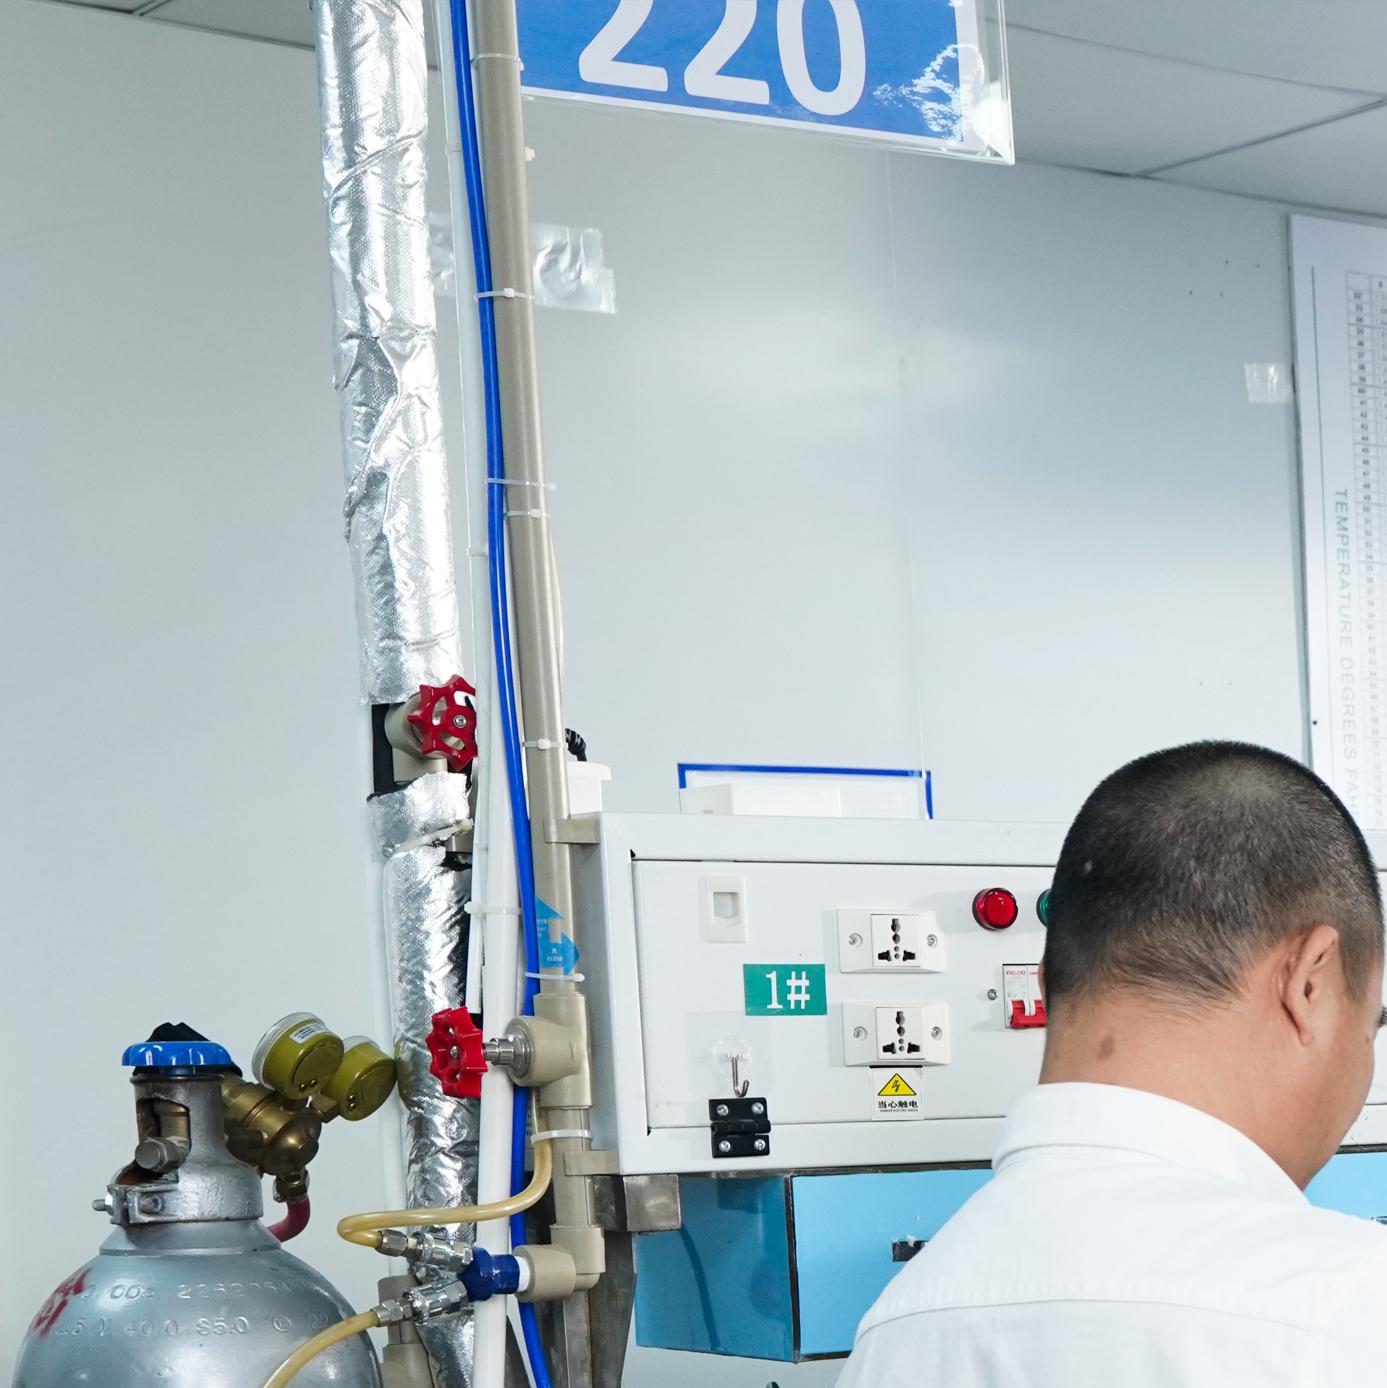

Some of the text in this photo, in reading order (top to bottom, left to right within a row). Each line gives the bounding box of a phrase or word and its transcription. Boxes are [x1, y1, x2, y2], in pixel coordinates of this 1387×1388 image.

[1334, 488, 1353, 648] TEMPERATURE
[1341, 656, 1357, 760] DEGREES
[766, 971, 811, 1010] 1#
[877, 1100, 919, 1109] 当心触电
